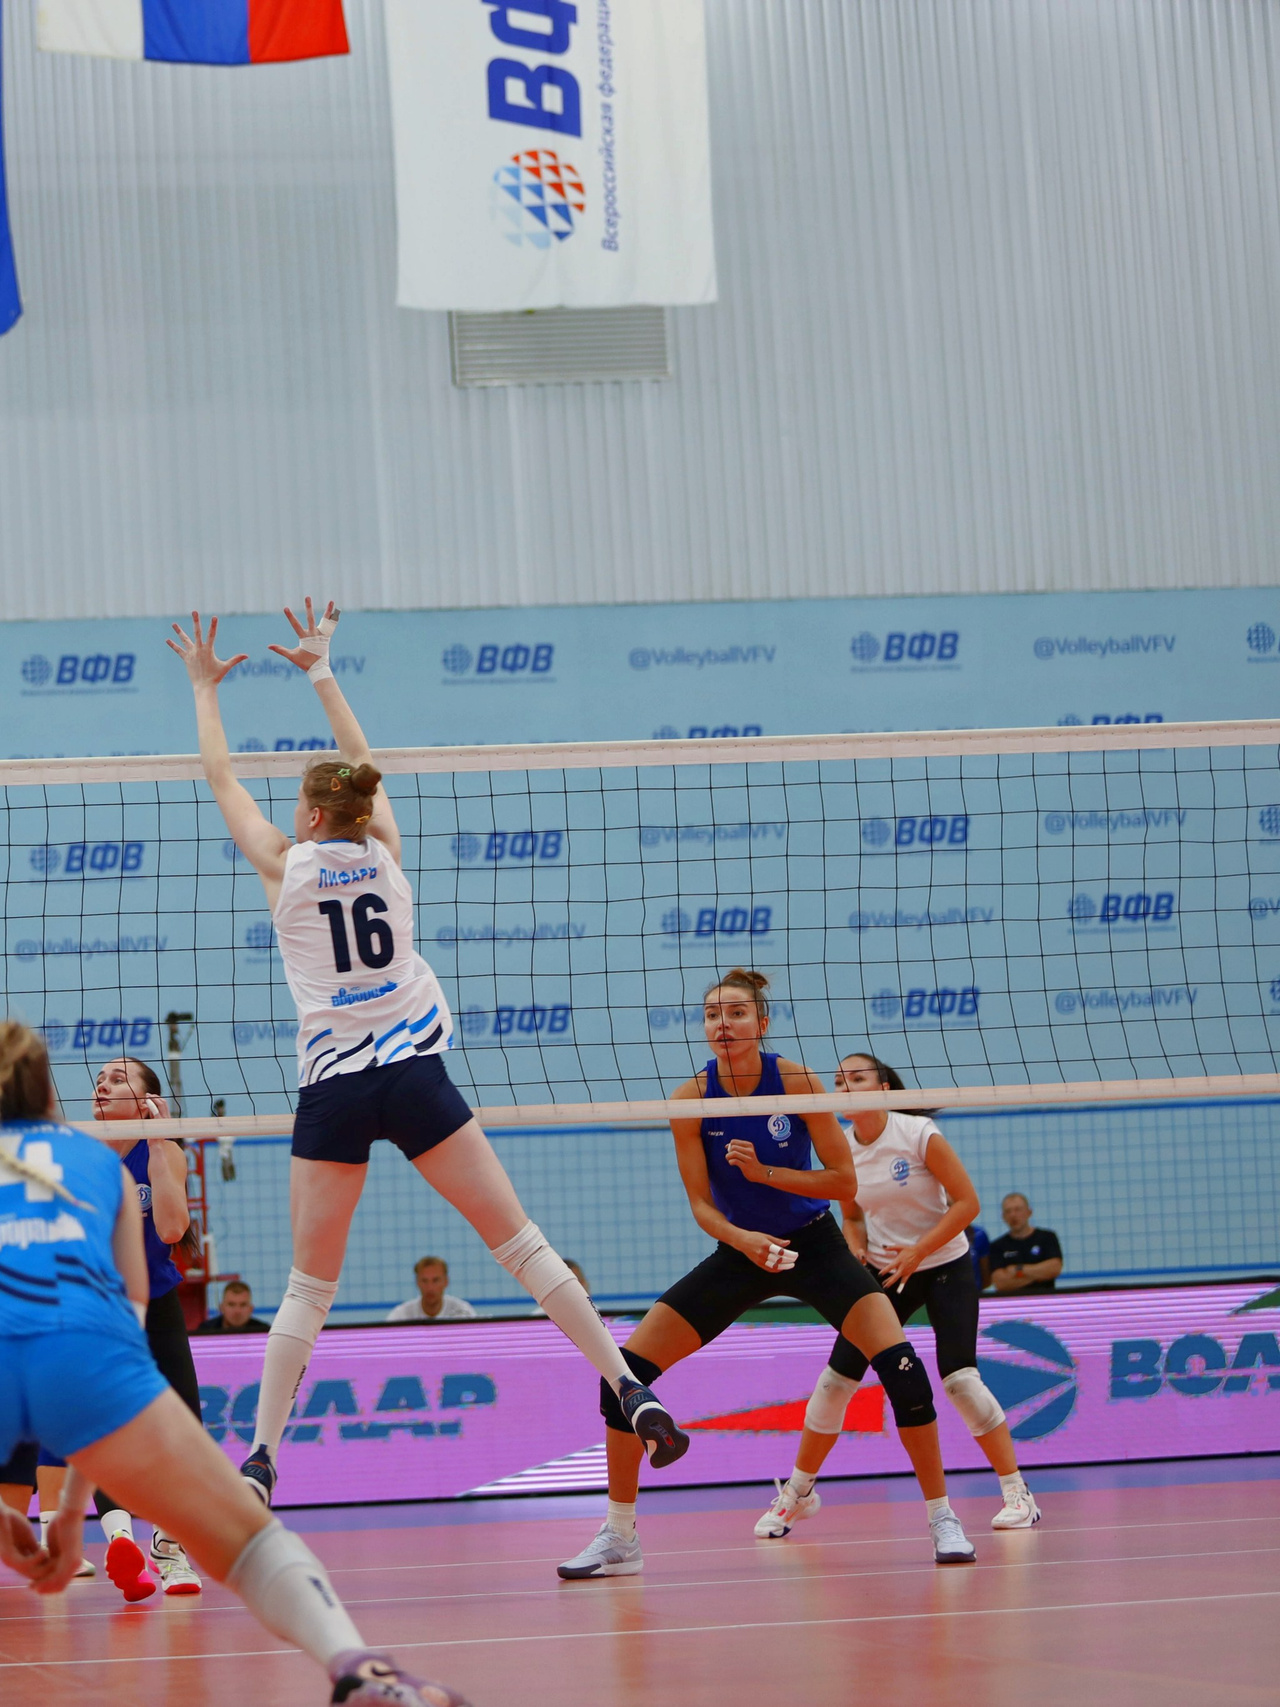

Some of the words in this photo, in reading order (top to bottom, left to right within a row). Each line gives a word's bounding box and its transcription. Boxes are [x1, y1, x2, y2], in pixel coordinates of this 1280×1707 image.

[475, 643, 555, 675] ВФВ
[883, 631, 959, 661] ВФВ
[56, 653, 136, 685] ВФВ
[484, 829, 563, 862] ВФВ
[894, 814, 971, 847] ВФВ
[64, 842, 144, 873] ВФВ
[695, 906, 773, 937] ВФВ
[1099, 891, 1175, 924] ВФВ
[318, 893, 394, 973] 16
[905, 987, 981, 1019] ВФВ
[73, 1017, 153, 1049] ВФВ
[492, 1004, 571, 1036] ВФВ
